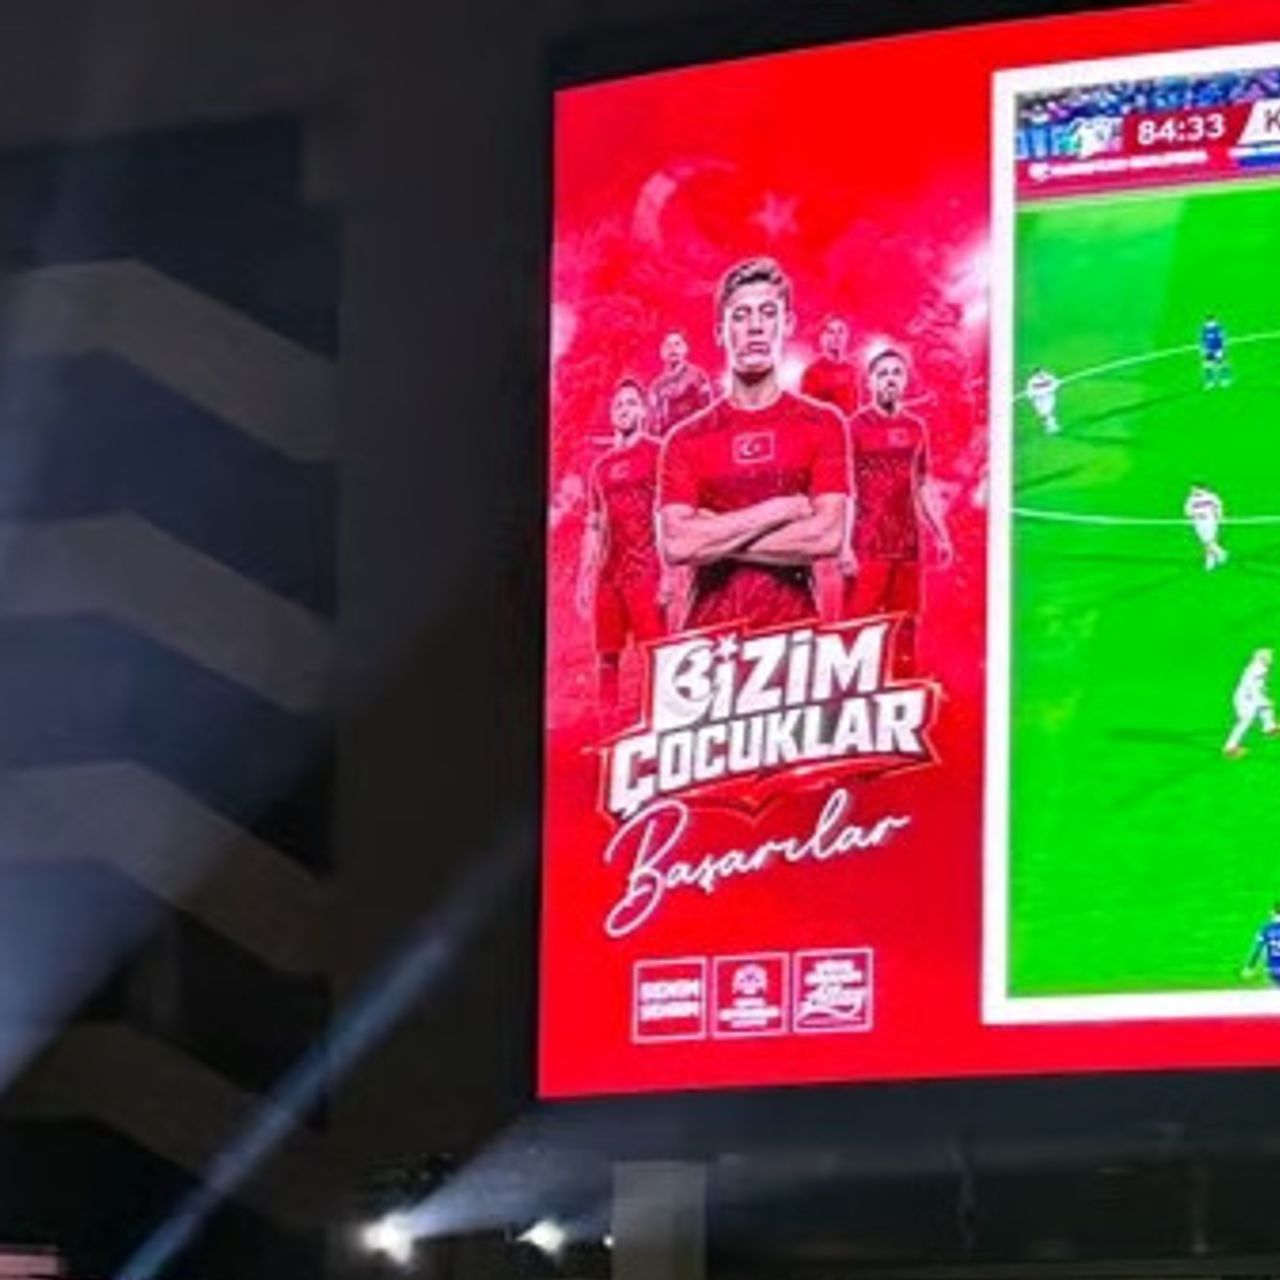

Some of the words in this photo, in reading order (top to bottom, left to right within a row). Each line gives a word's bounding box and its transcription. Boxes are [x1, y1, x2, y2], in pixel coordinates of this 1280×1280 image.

[1137, 113, 1226, 145] 84:33
[653, 622, 889, 731] BİZİM
[608, 689, 926, 820] ÇOCUKLAR
[603, 788, 912, 938] Başarılar
